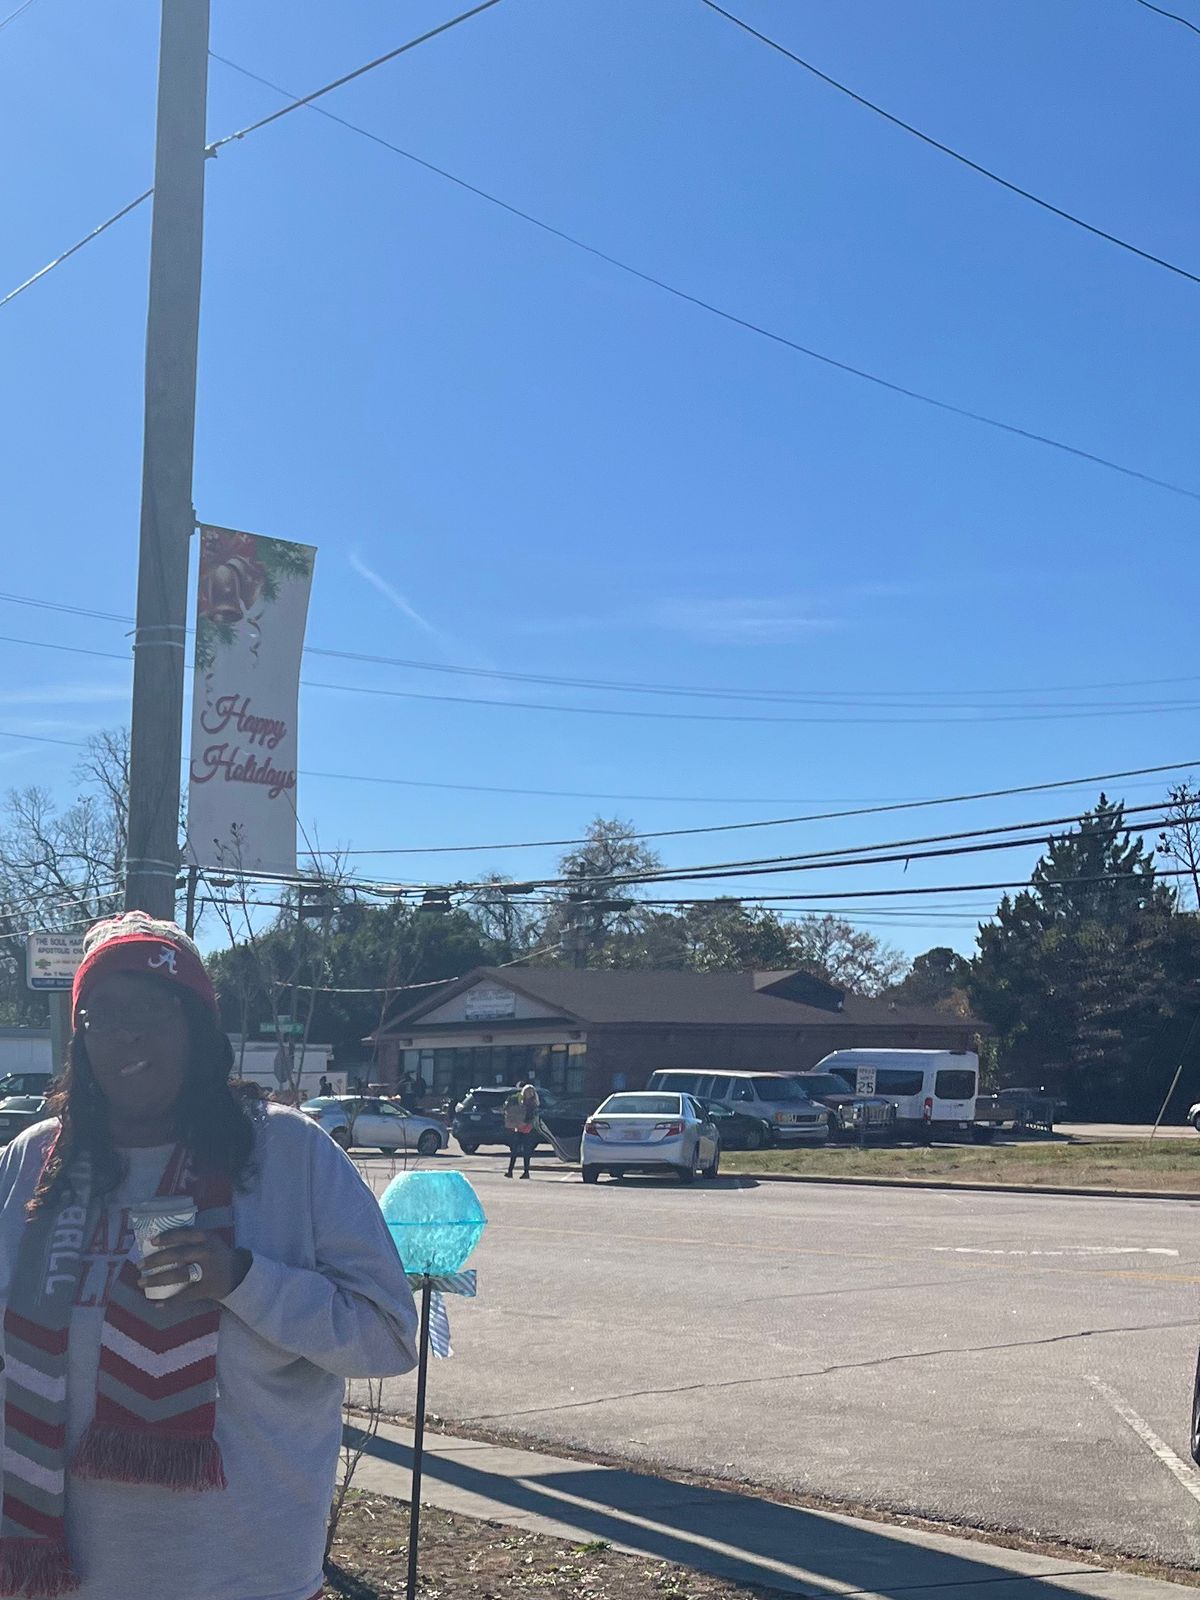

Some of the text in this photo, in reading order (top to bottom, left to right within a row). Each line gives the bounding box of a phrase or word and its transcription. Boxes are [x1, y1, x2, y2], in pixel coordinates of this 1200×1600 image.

[200, 694, 287, 749] Happy
[190, 743, 297, 800] Holidays
[35, 937, 48, 946] THE
[50, 937, 68, 946] SOUL
[858, 1081, 874, 1094] 25
